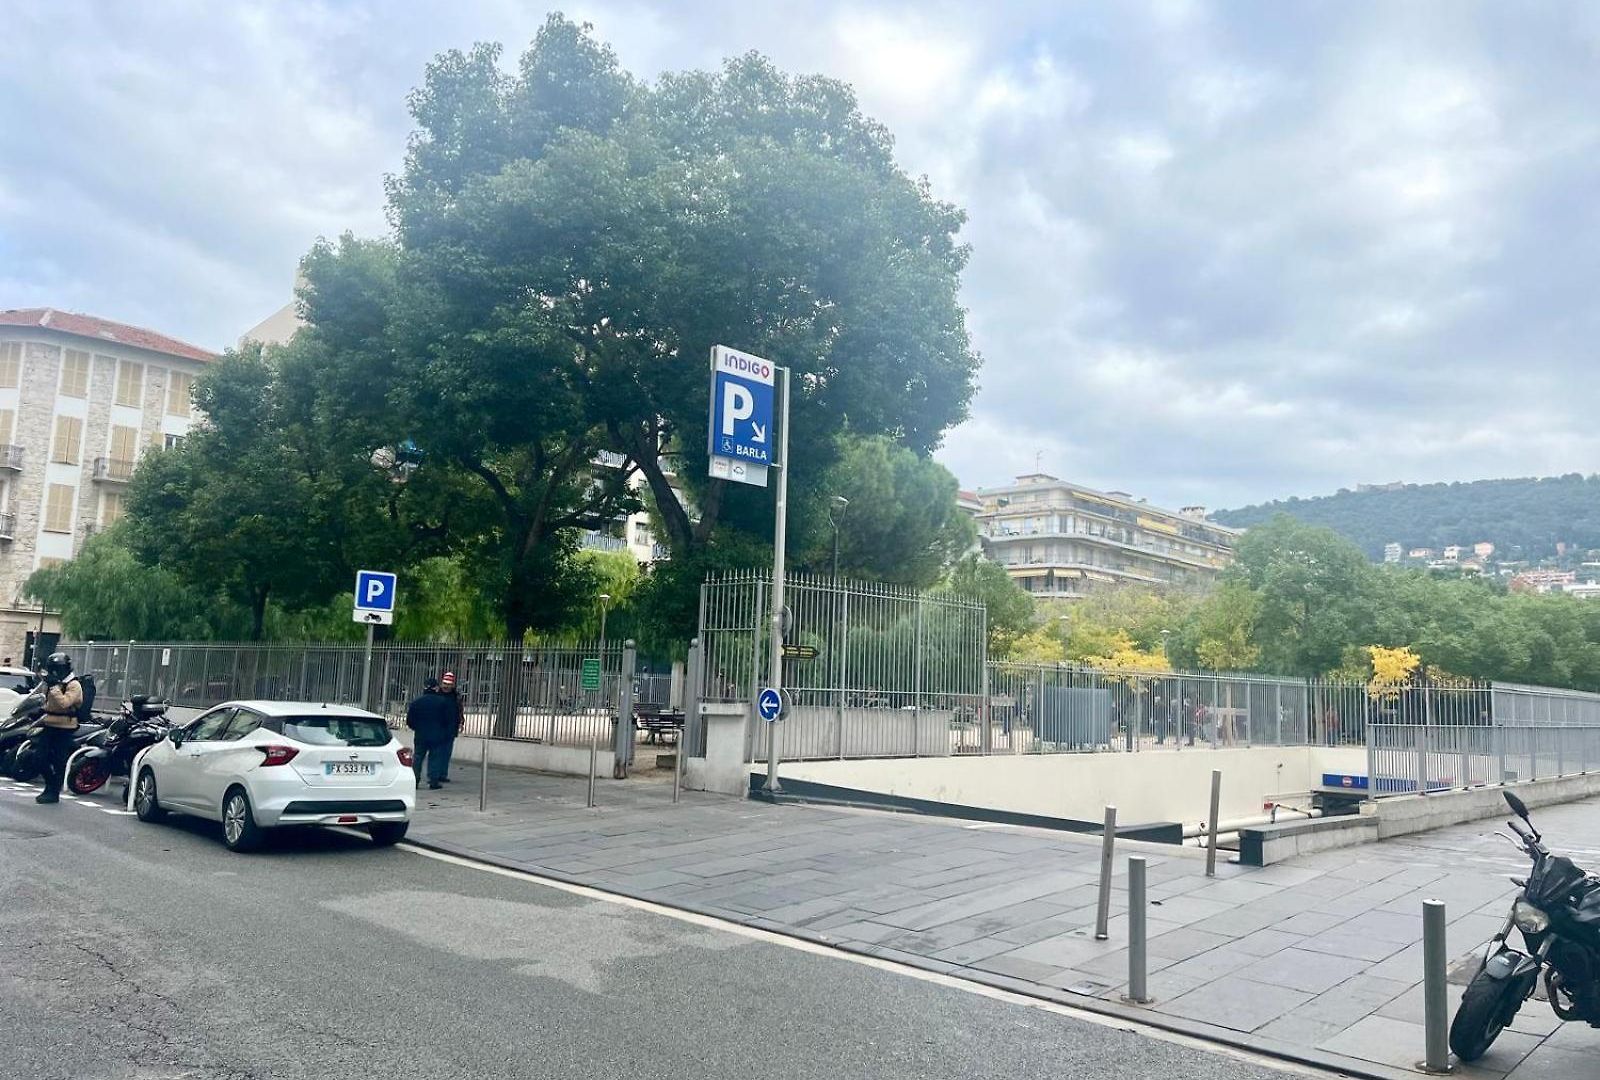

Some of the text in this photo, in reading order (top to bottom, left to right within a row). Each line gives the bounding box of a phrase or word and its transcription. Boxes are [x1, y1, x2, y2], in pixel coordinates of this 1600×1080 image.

[724, 353, 770, 379] INDIGO
[723, 381, 754, 436] P
[736, 445, 767, 461] BARLA
[367, 579, 385, 603] P
[332, 763, 341, 773] FX
